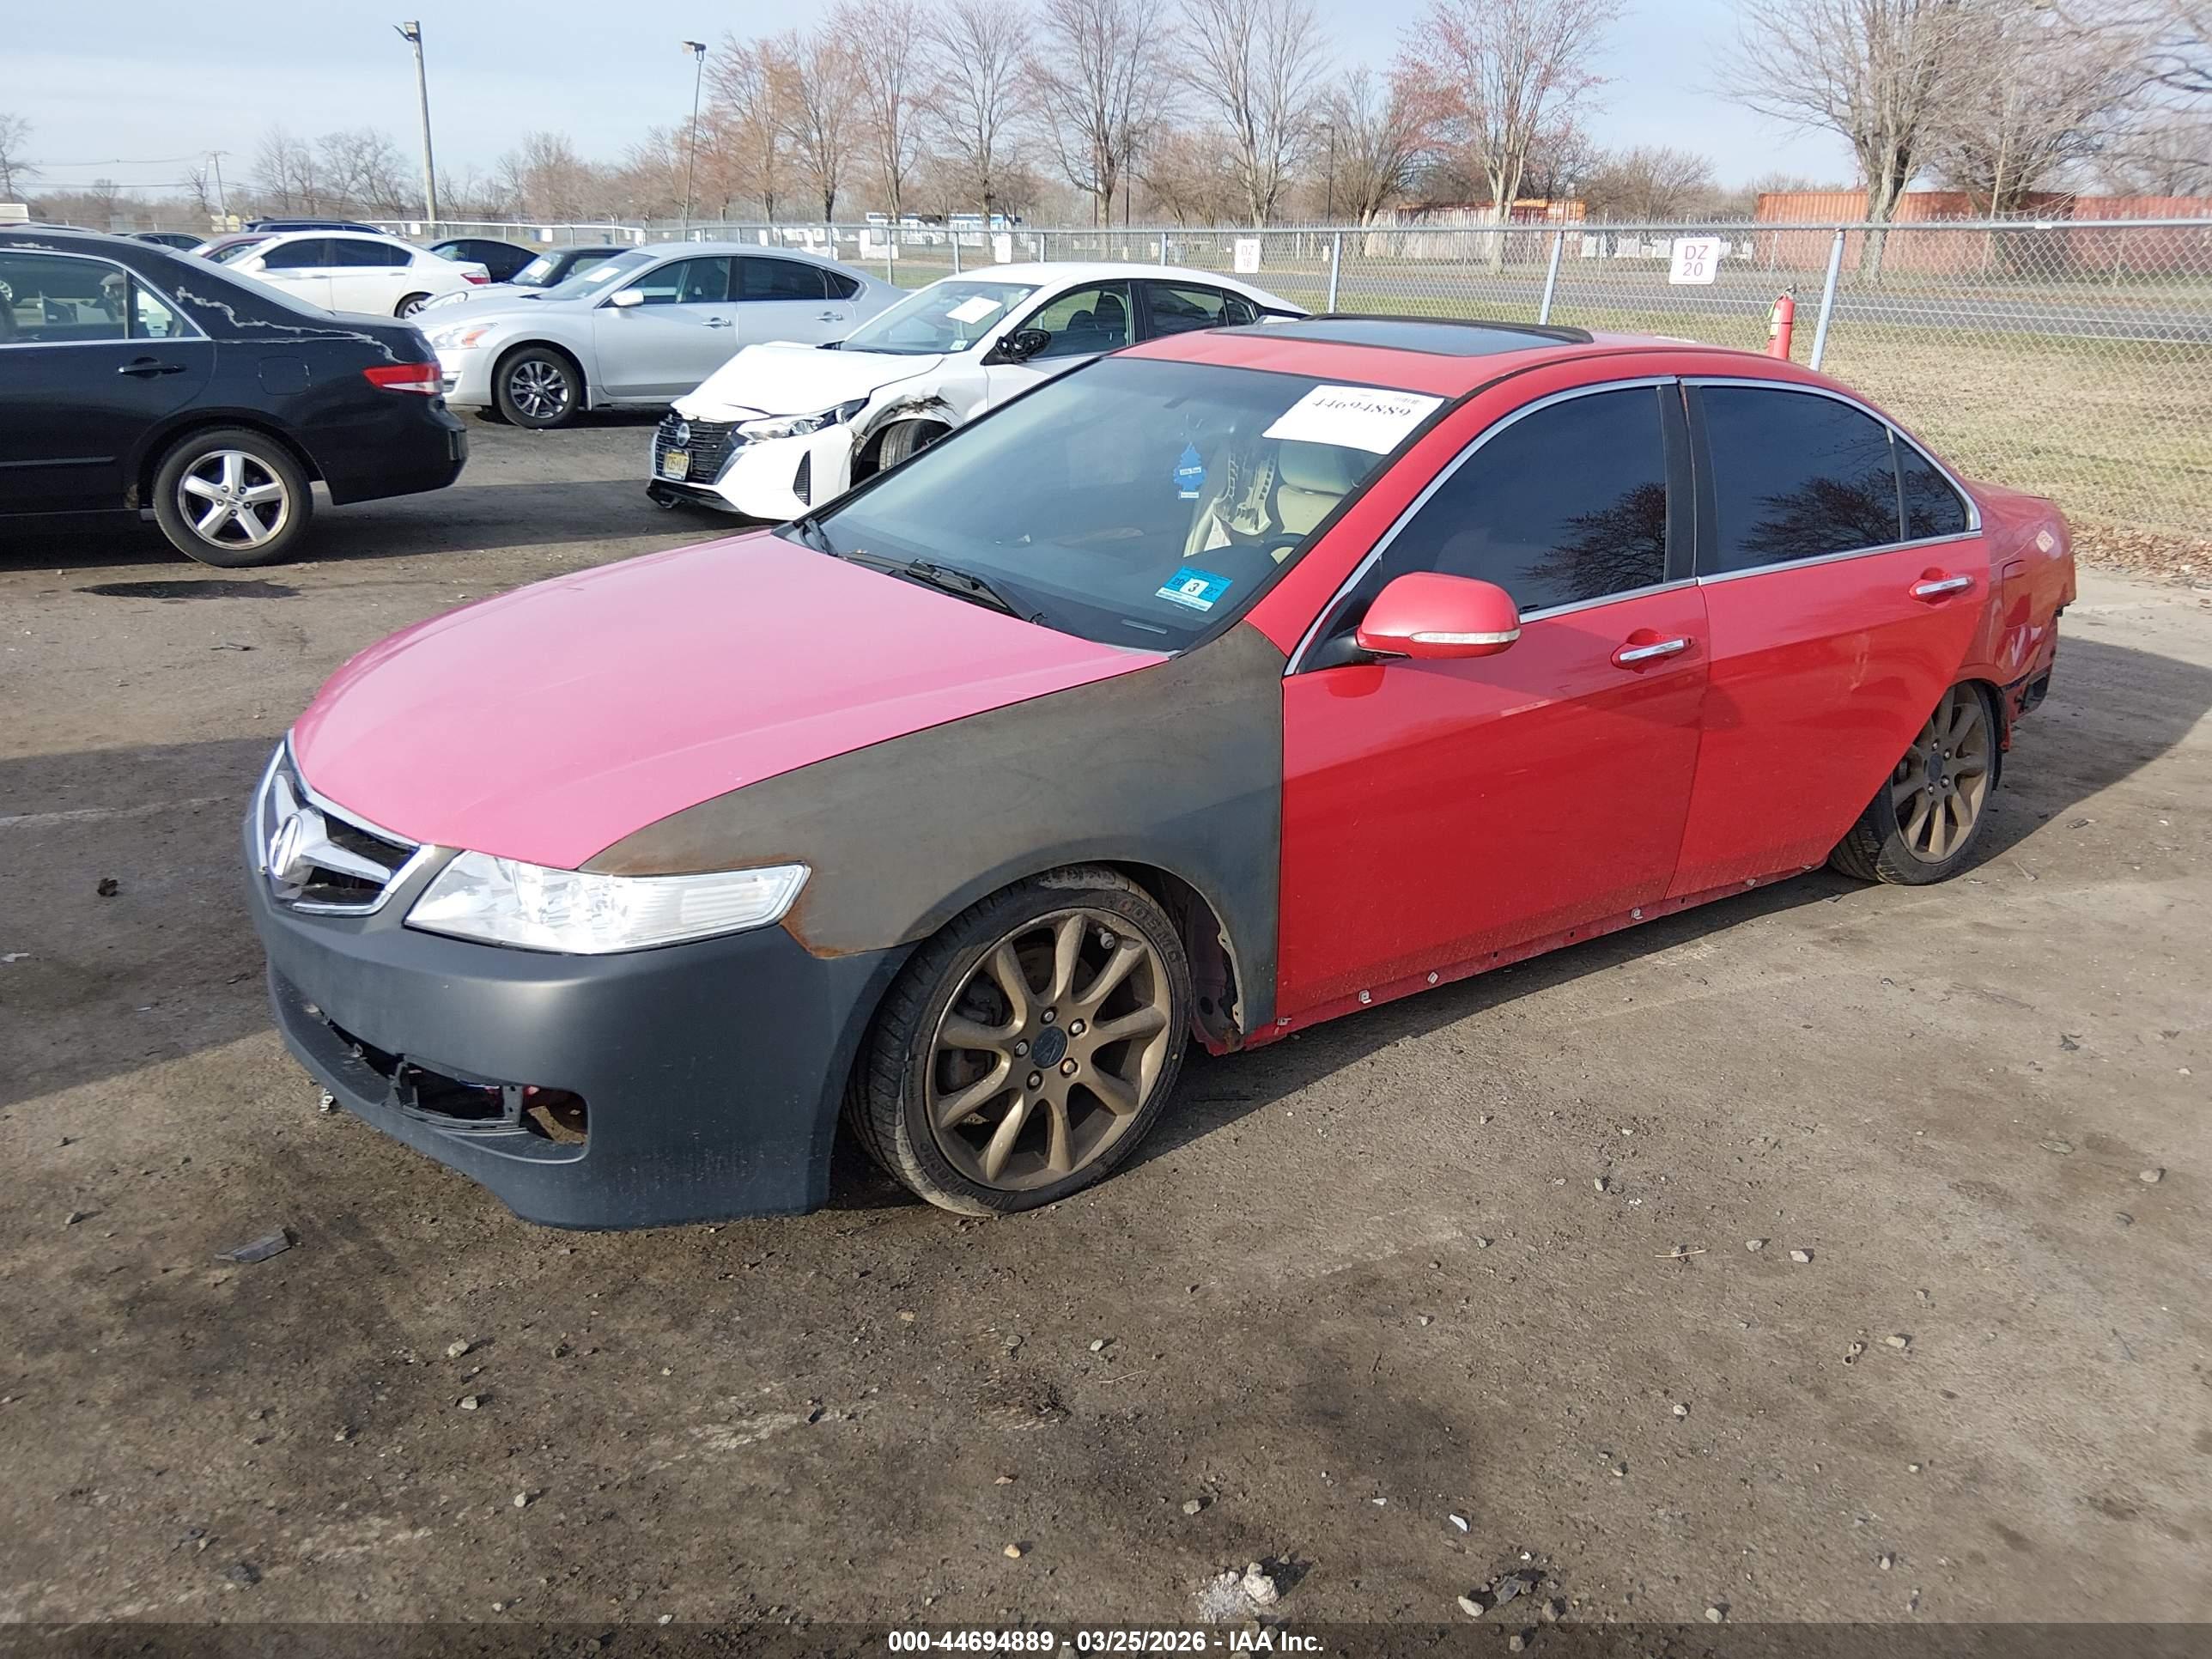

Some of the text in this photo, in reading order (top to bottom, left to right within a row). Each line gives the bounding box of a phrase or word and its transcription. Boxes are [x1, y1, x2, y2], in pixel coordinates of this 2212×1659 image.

[1685, 245, 1709, 260] DZ
[1682, 262, 1704, 276] 20
[1188, 582, 1200, 592] 3
